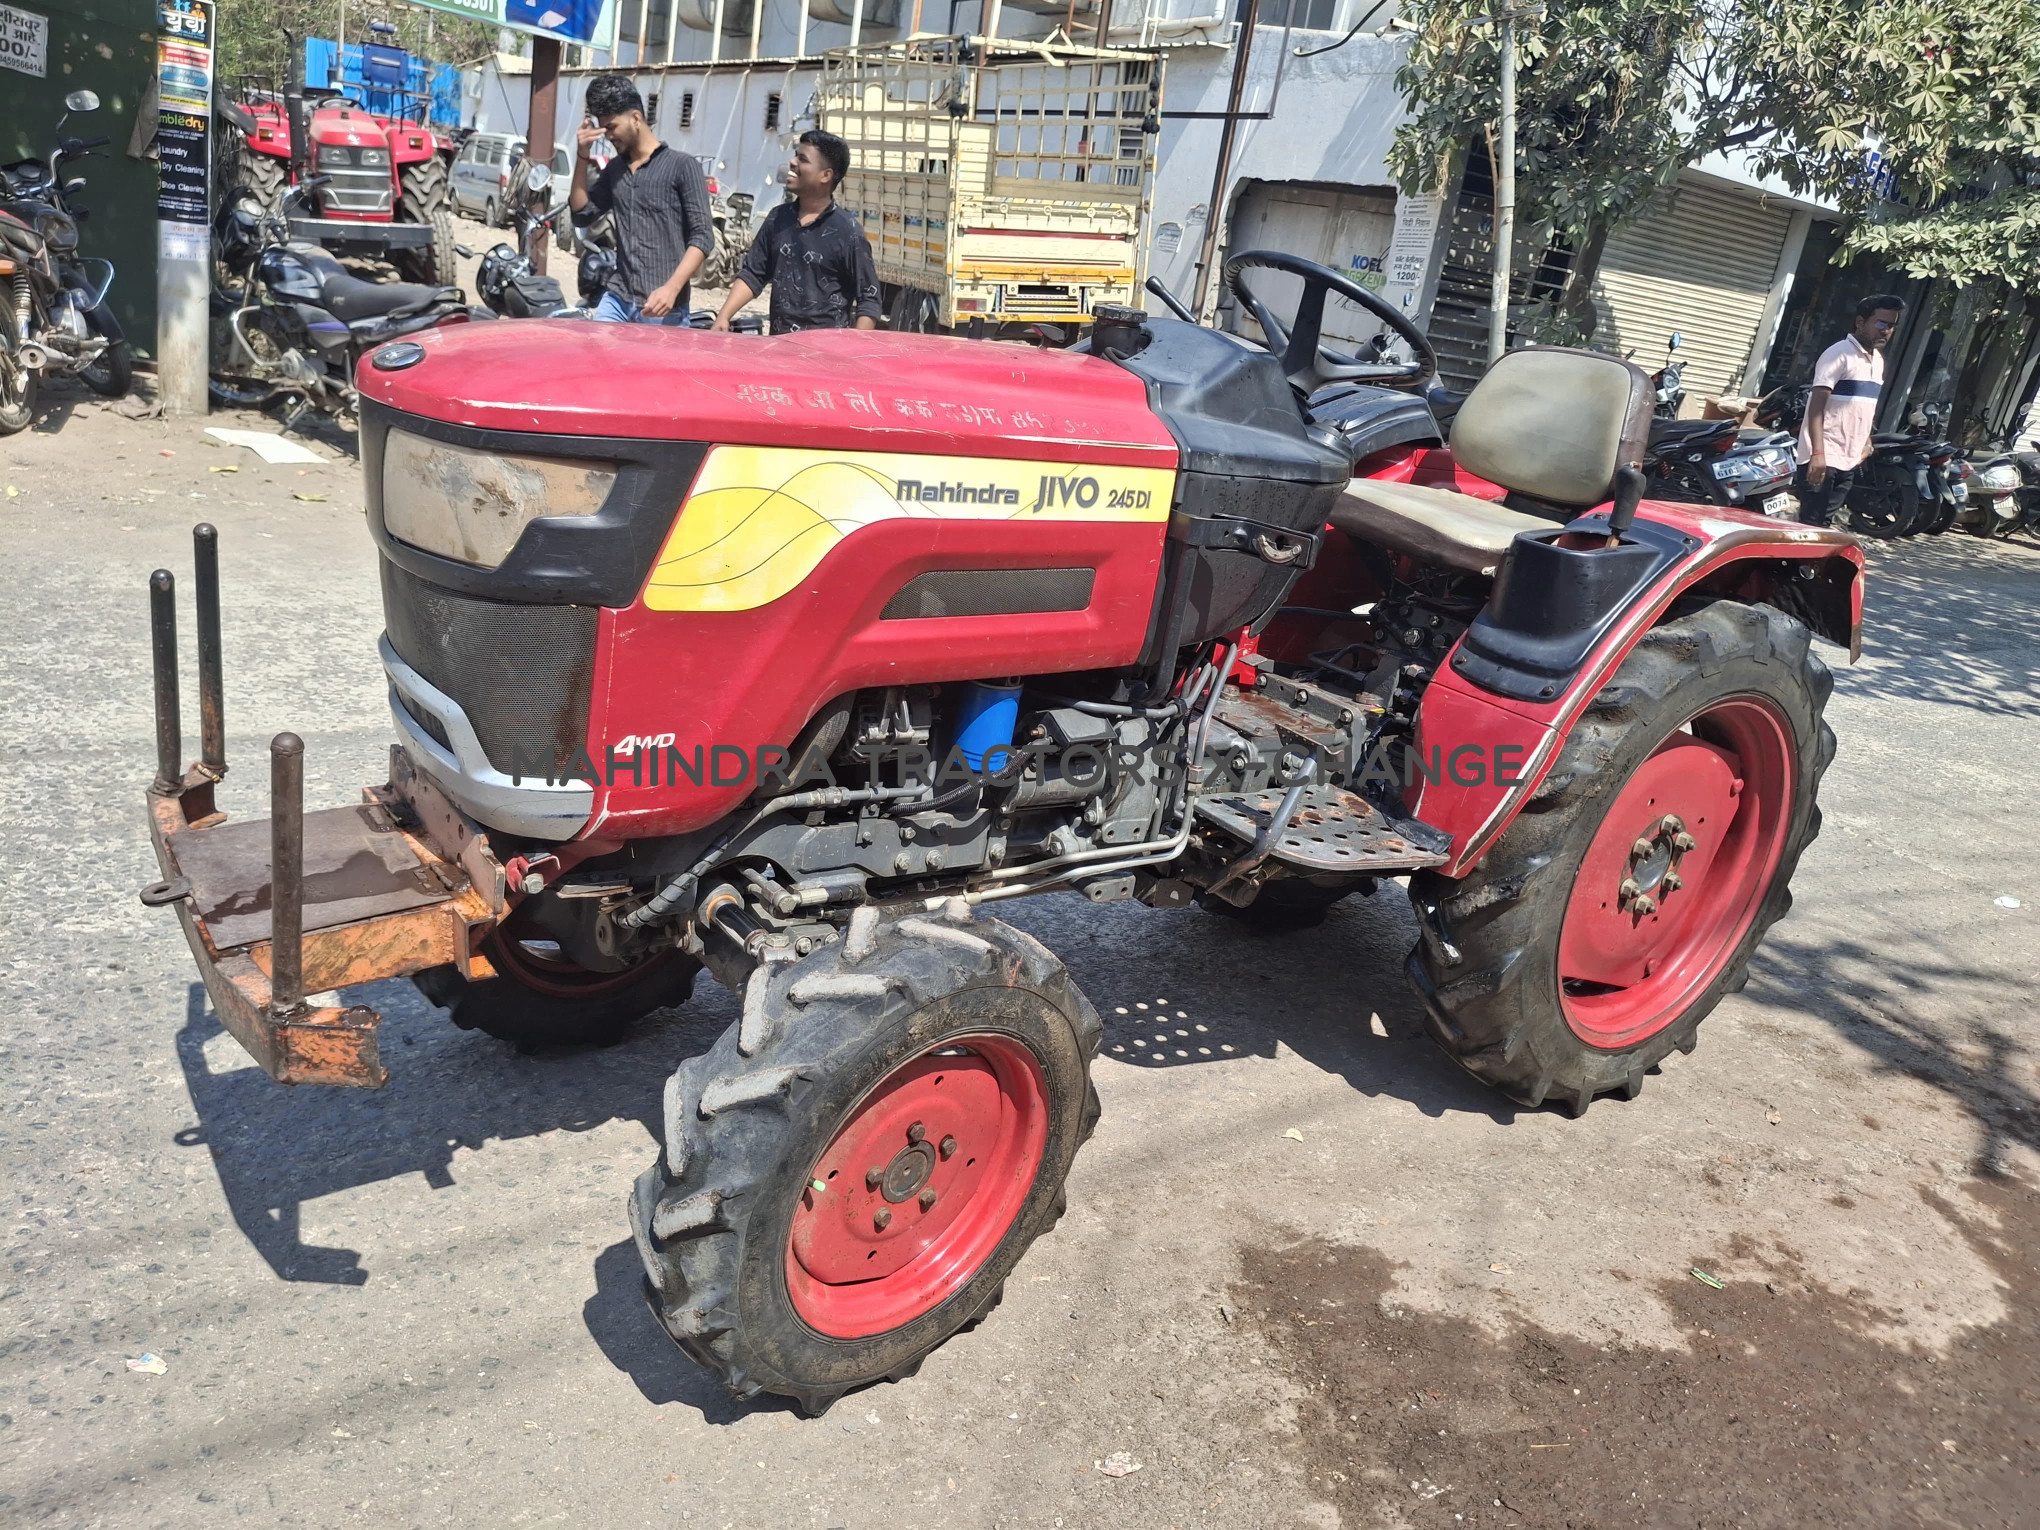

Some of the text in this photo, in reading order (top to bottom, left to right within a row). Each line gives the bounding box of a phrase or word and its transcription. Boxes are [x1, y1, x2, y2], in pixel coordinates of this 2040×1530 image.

[161, 145, 189, 159] Laundry
[161, 161, 205, 177] Dry Cleaning
[177, 182, 205, 195] Cleaning
[1351, 254, 1383, 273] KOEL
[896, 479, 1020, 506] Mahindra
[1032, 475, 1100, 514] JIVO
[612, 732, 676, 756] 4WD
